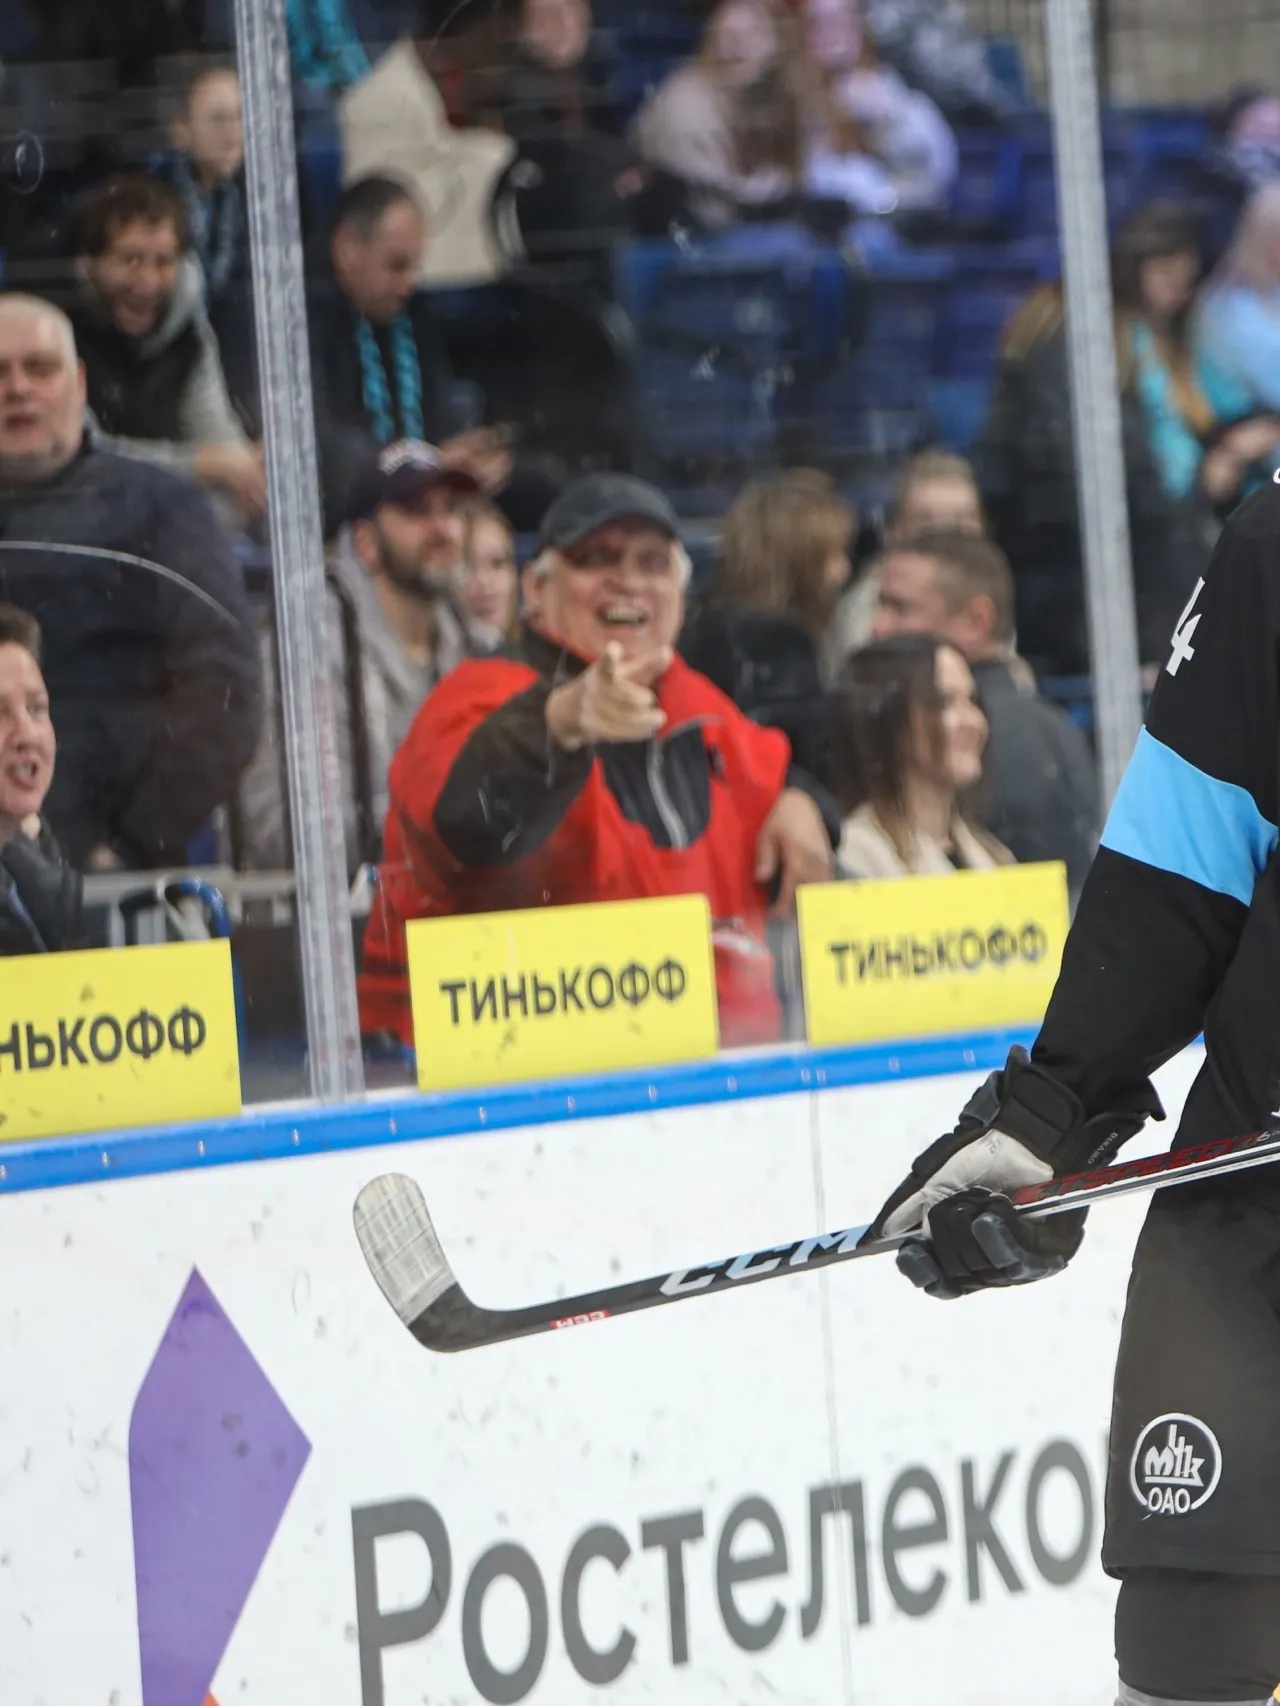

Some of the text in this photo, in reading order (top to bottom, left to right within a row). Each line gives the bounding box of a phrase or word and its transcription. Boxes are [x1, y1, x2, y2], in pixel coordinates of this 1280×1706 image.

[829, 922, 1049, 987] ТИНЬКОФФ
[440, 956, 687, 1027] ТИНЬКОФФ
[659, 1223, 872, 1297] CCM
[351, 1428, 1112, 1706] Ростелеко
